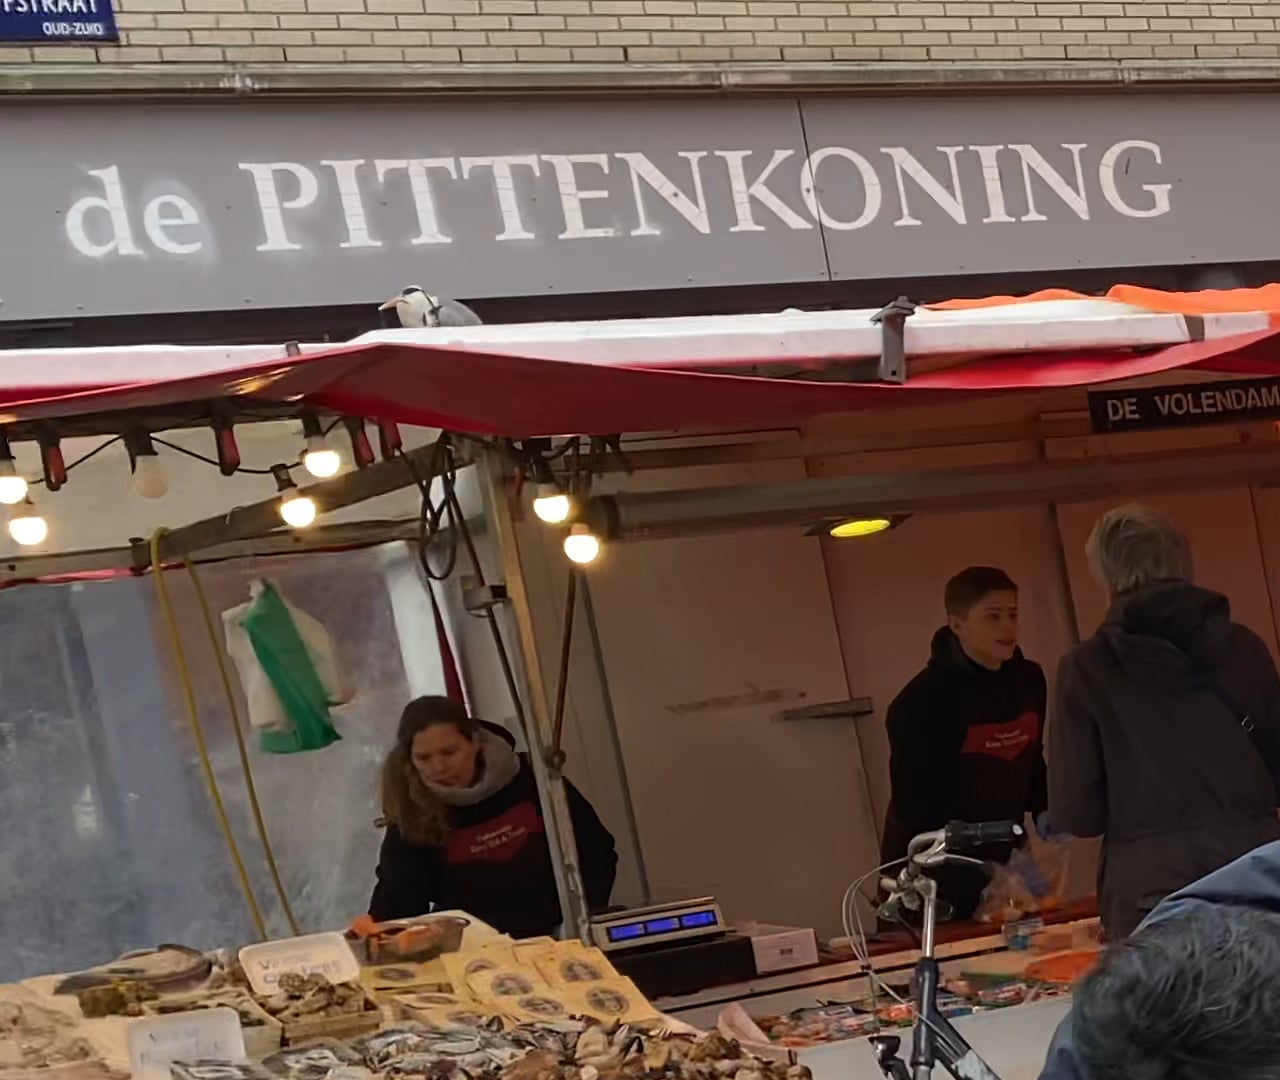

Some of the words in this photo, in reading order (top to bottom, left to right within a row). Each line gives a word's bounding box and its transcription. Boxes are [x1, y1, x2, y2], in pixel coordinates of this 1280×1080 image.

[42, 21, 104, 36] OUD-ZUID
[65, 164, 202, 259] de
[238, 139, 1172, 252] PITTENKONING
[1106, 398, 1140, 422] DE
